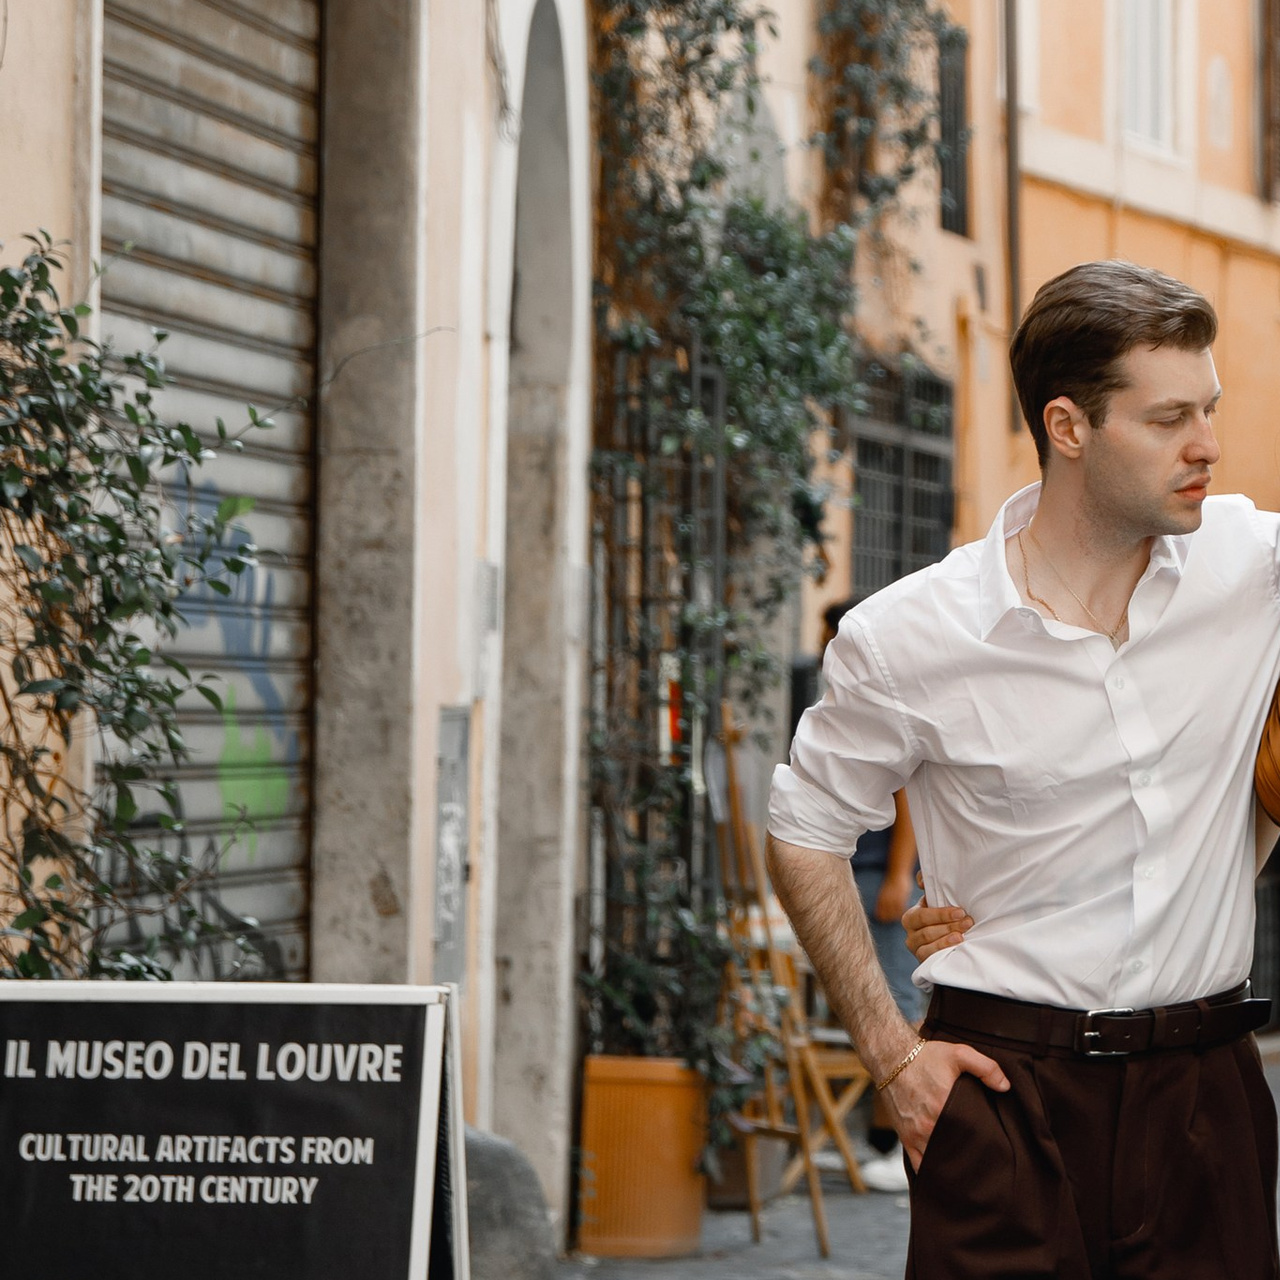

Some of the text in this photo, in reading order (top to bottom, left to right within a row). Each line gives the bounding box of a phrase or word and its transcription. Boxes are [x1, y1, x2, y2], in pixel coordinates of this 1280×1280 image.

[4, 1039, 404, 1083] IL MUSEO DEL LOUVRE
[18, 1132, 376, 1165] CULTURAL ARTIFACTS FROM
[69, 1173, 319, 1204] THE 20TH CENTURY
